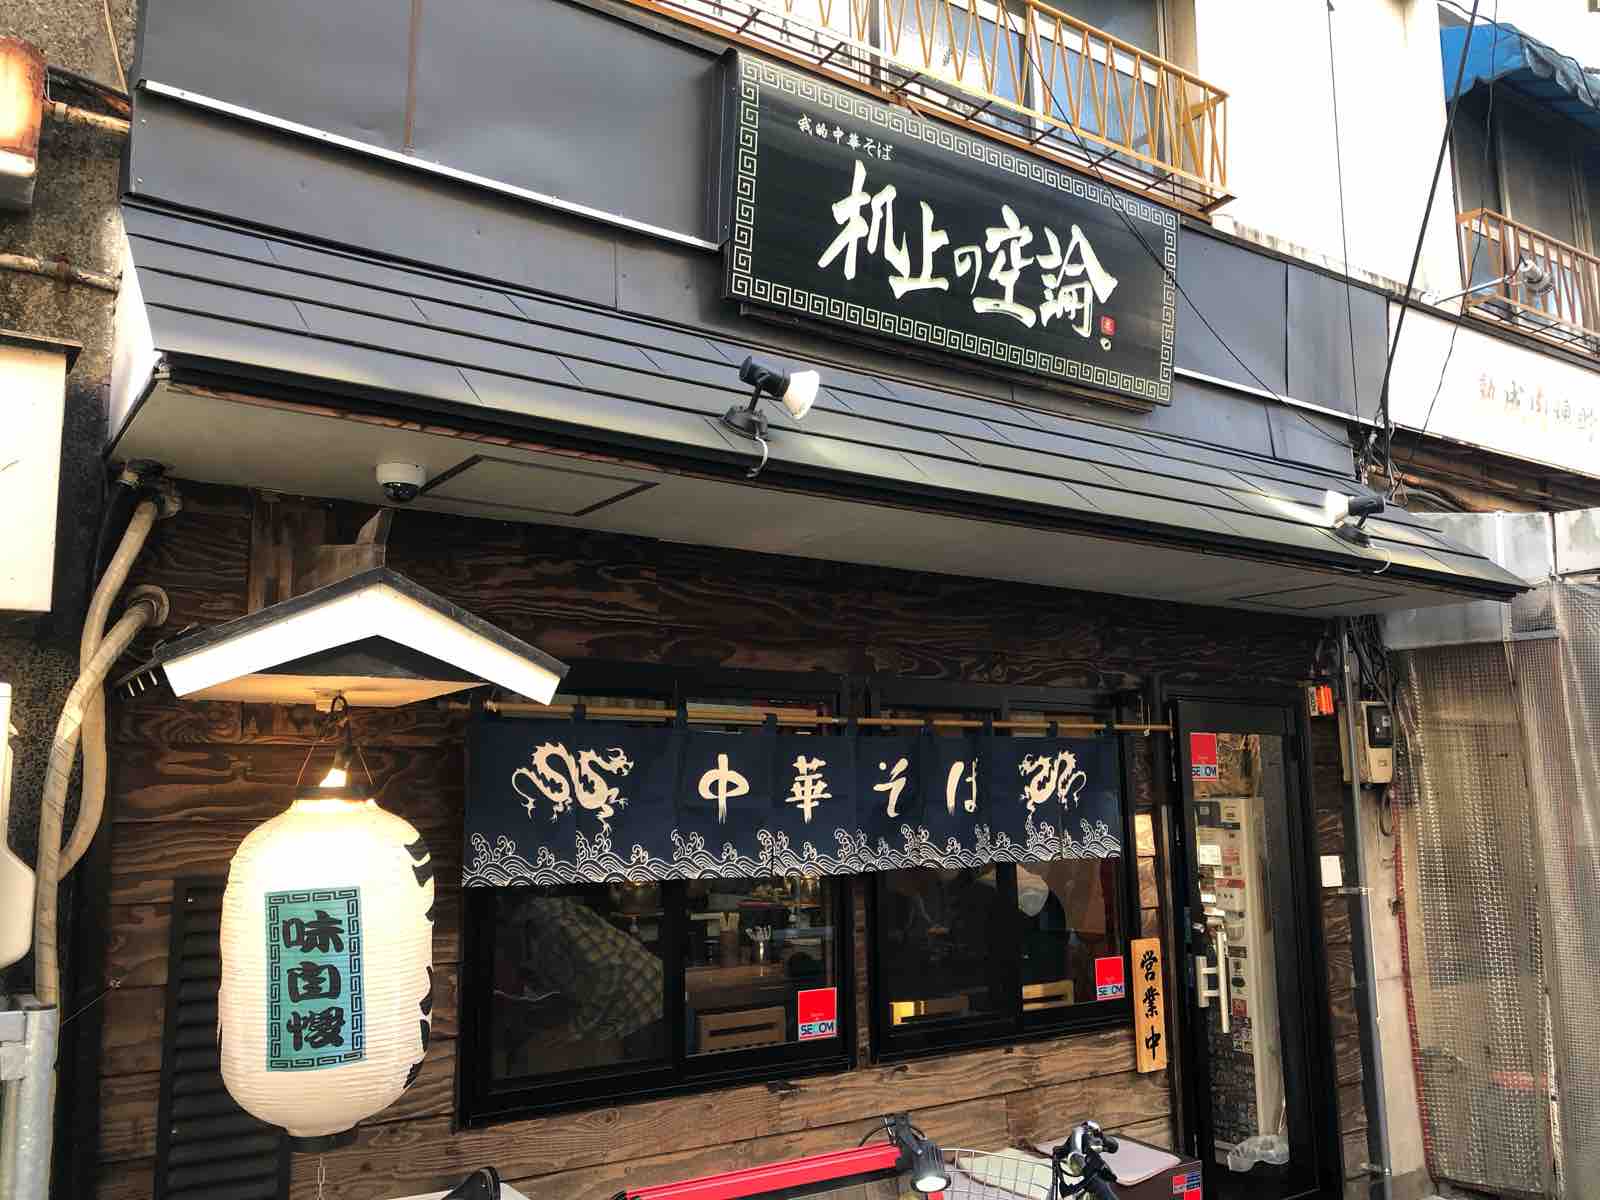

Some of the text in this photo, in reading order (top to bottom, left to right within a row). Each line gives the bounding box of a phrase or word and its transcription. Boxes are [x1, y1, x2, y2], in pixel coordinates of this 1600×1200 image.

[797, 115, 894, 161] 我的中華そば
[1140, 949, 1162, 1061] 営業中
